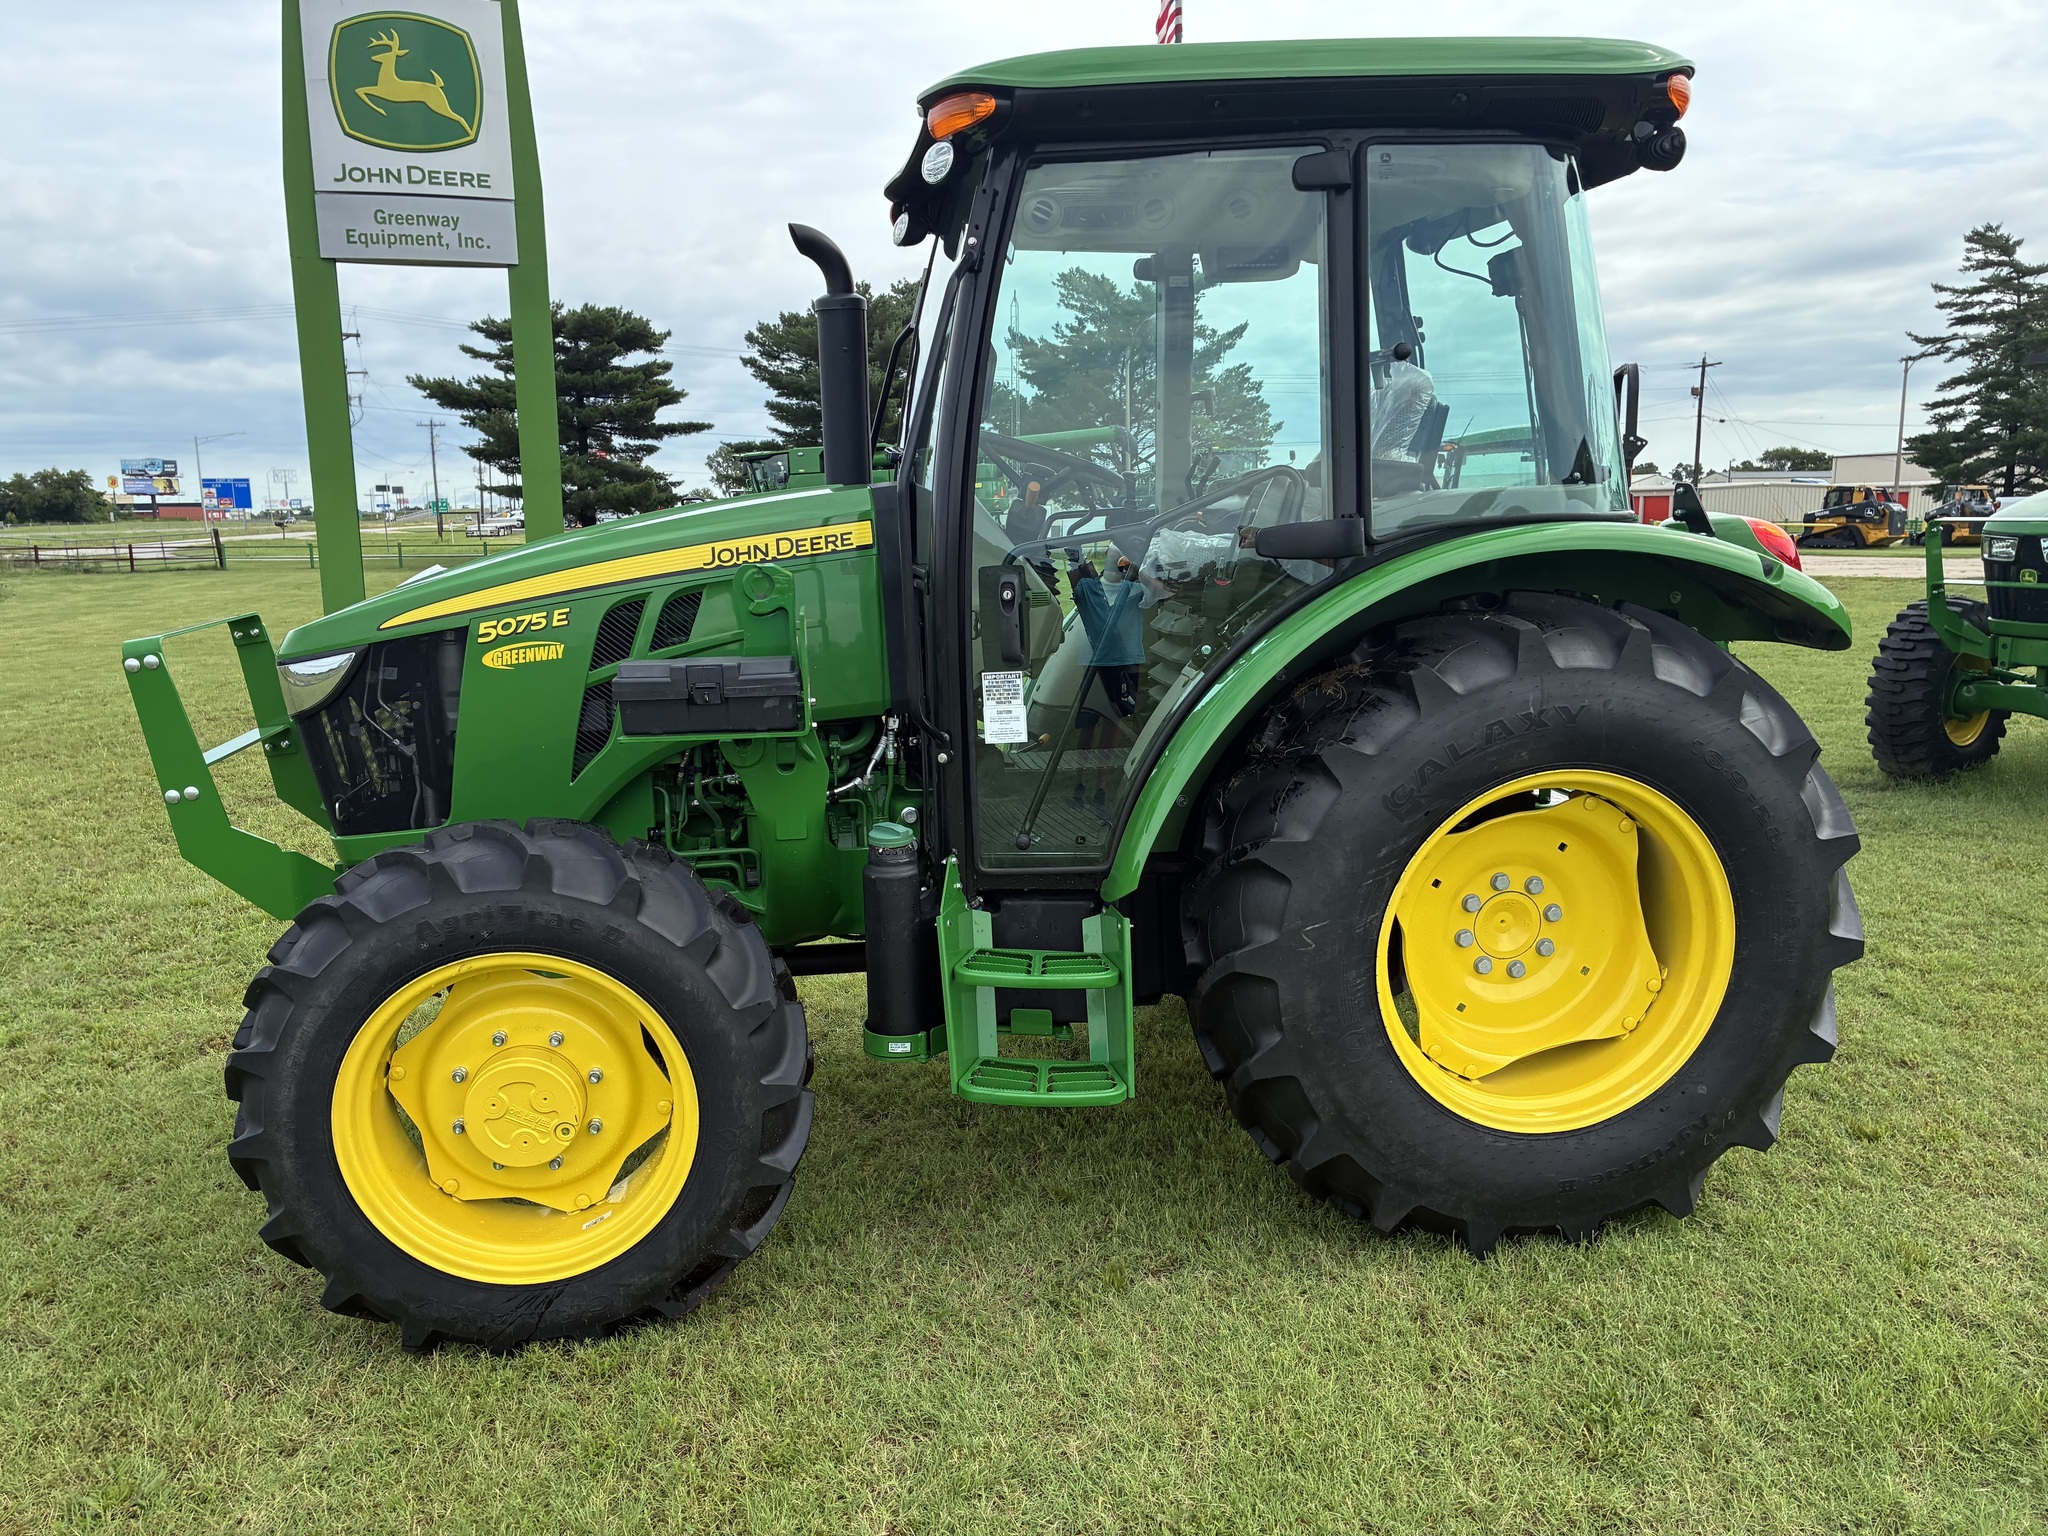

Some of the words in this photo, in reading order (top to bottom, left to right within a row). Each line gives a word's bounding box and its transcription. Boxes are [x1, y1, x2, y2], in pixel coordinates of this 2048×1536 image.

[334, 163, 402, 184] JOHN
[407, 165, 492, 189] DEERE
[373, 209, 460, 231] Greenway
[345, 228, 450, 250] Equipment,
[457, 232, 491, 250] Inc.
[703, 542, 770, 569] JOHN
[776, 531, 854, 559] DEERE
[477, 610, 549, 644] 5075
[551, 606, 570, 628] E
[491, 642, 565, 667] GREENWAY
[1385, 703, 1588, 812] GALAXY
[1690, 737, 1784, 850] 16.9-28
[414, 903, 586, 939] AgriTrac
[508, 1105, 522, 1121] OIL
[523, 1111, 550, 1129] LEVEL
[1590, 1111, 1709, 1186] AgriTrac
